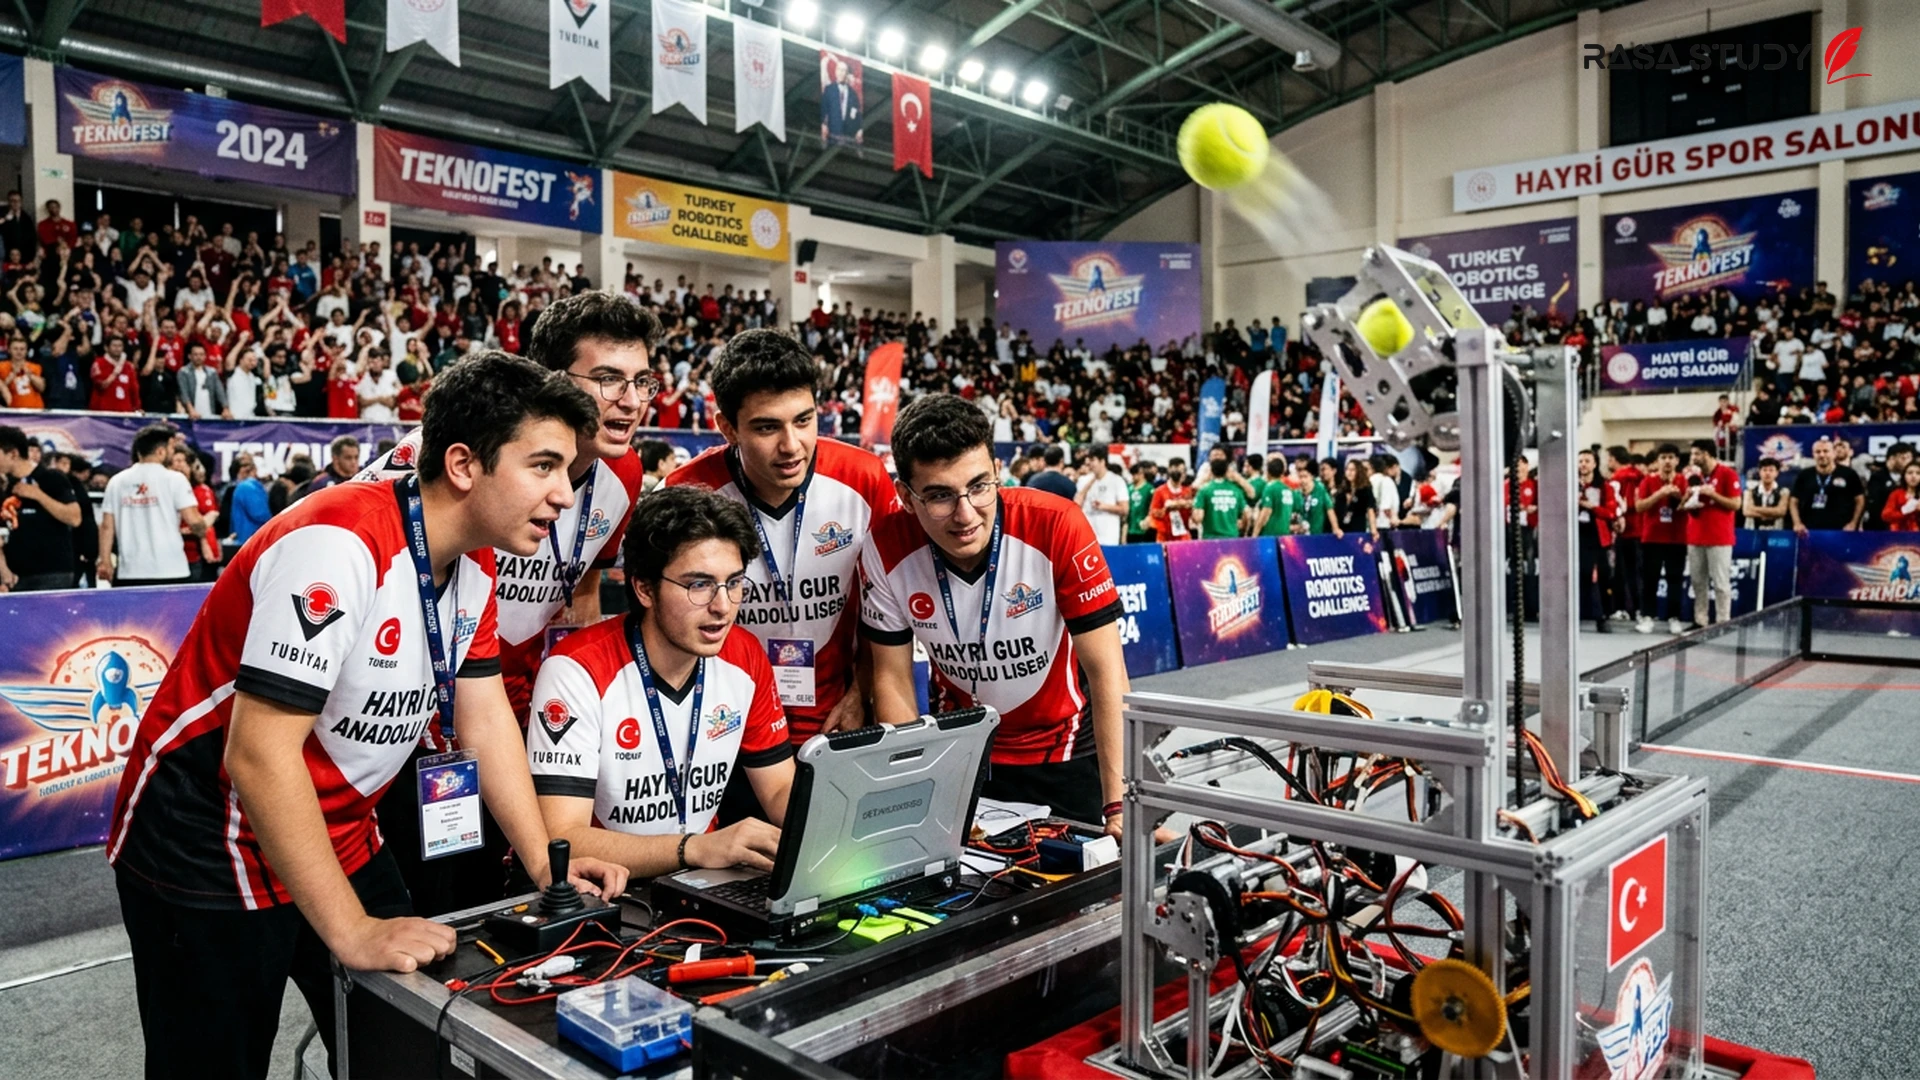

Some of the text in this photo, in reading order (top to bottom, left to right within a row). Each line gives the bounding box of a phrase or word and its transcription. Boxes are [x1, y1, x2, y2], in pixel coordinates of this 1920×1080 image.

[216, 119, 308, 170] 2024
[400, 146, 557, 204] TEKNOFEST
[1515, 154, 1603, 195] HAYRİ
[1613, 148, 1675, 180] GÜR
[1686, 135, 1774, 171] SPOR
[684, 193, 736, 213] TURKEY
[677, 208, 744, 230] ROBOTICS
[672, 223, 749, 247] CHALLENGE
[1447, 246, 1526, 269] TURKEY
[1450, 264, 1539, 287] OBOTICS
[1464, 282, 1546, 305] LLENGE
[1641, 363, 1740, 380] SPOR SALONU
[1306, 556, 1355, 577] TURKEY
[496, 582, 548, 603] ADOLU
[800, 574, 840, 600] GUR
[1305, 576, 1366, 599] ROBOTICS
[735, 605, 800, 626] NADOLU
[1308, 595, 1371, 619] CHALLENGE
[993, 636, 1037, 661] GUR
[361, 684, 428, 718] HAYRİ
[330, 716, 420, 746] ANADOLU
[689, 761, 728, 790] GUR
[608, 798, 679, 825] ANADOL
